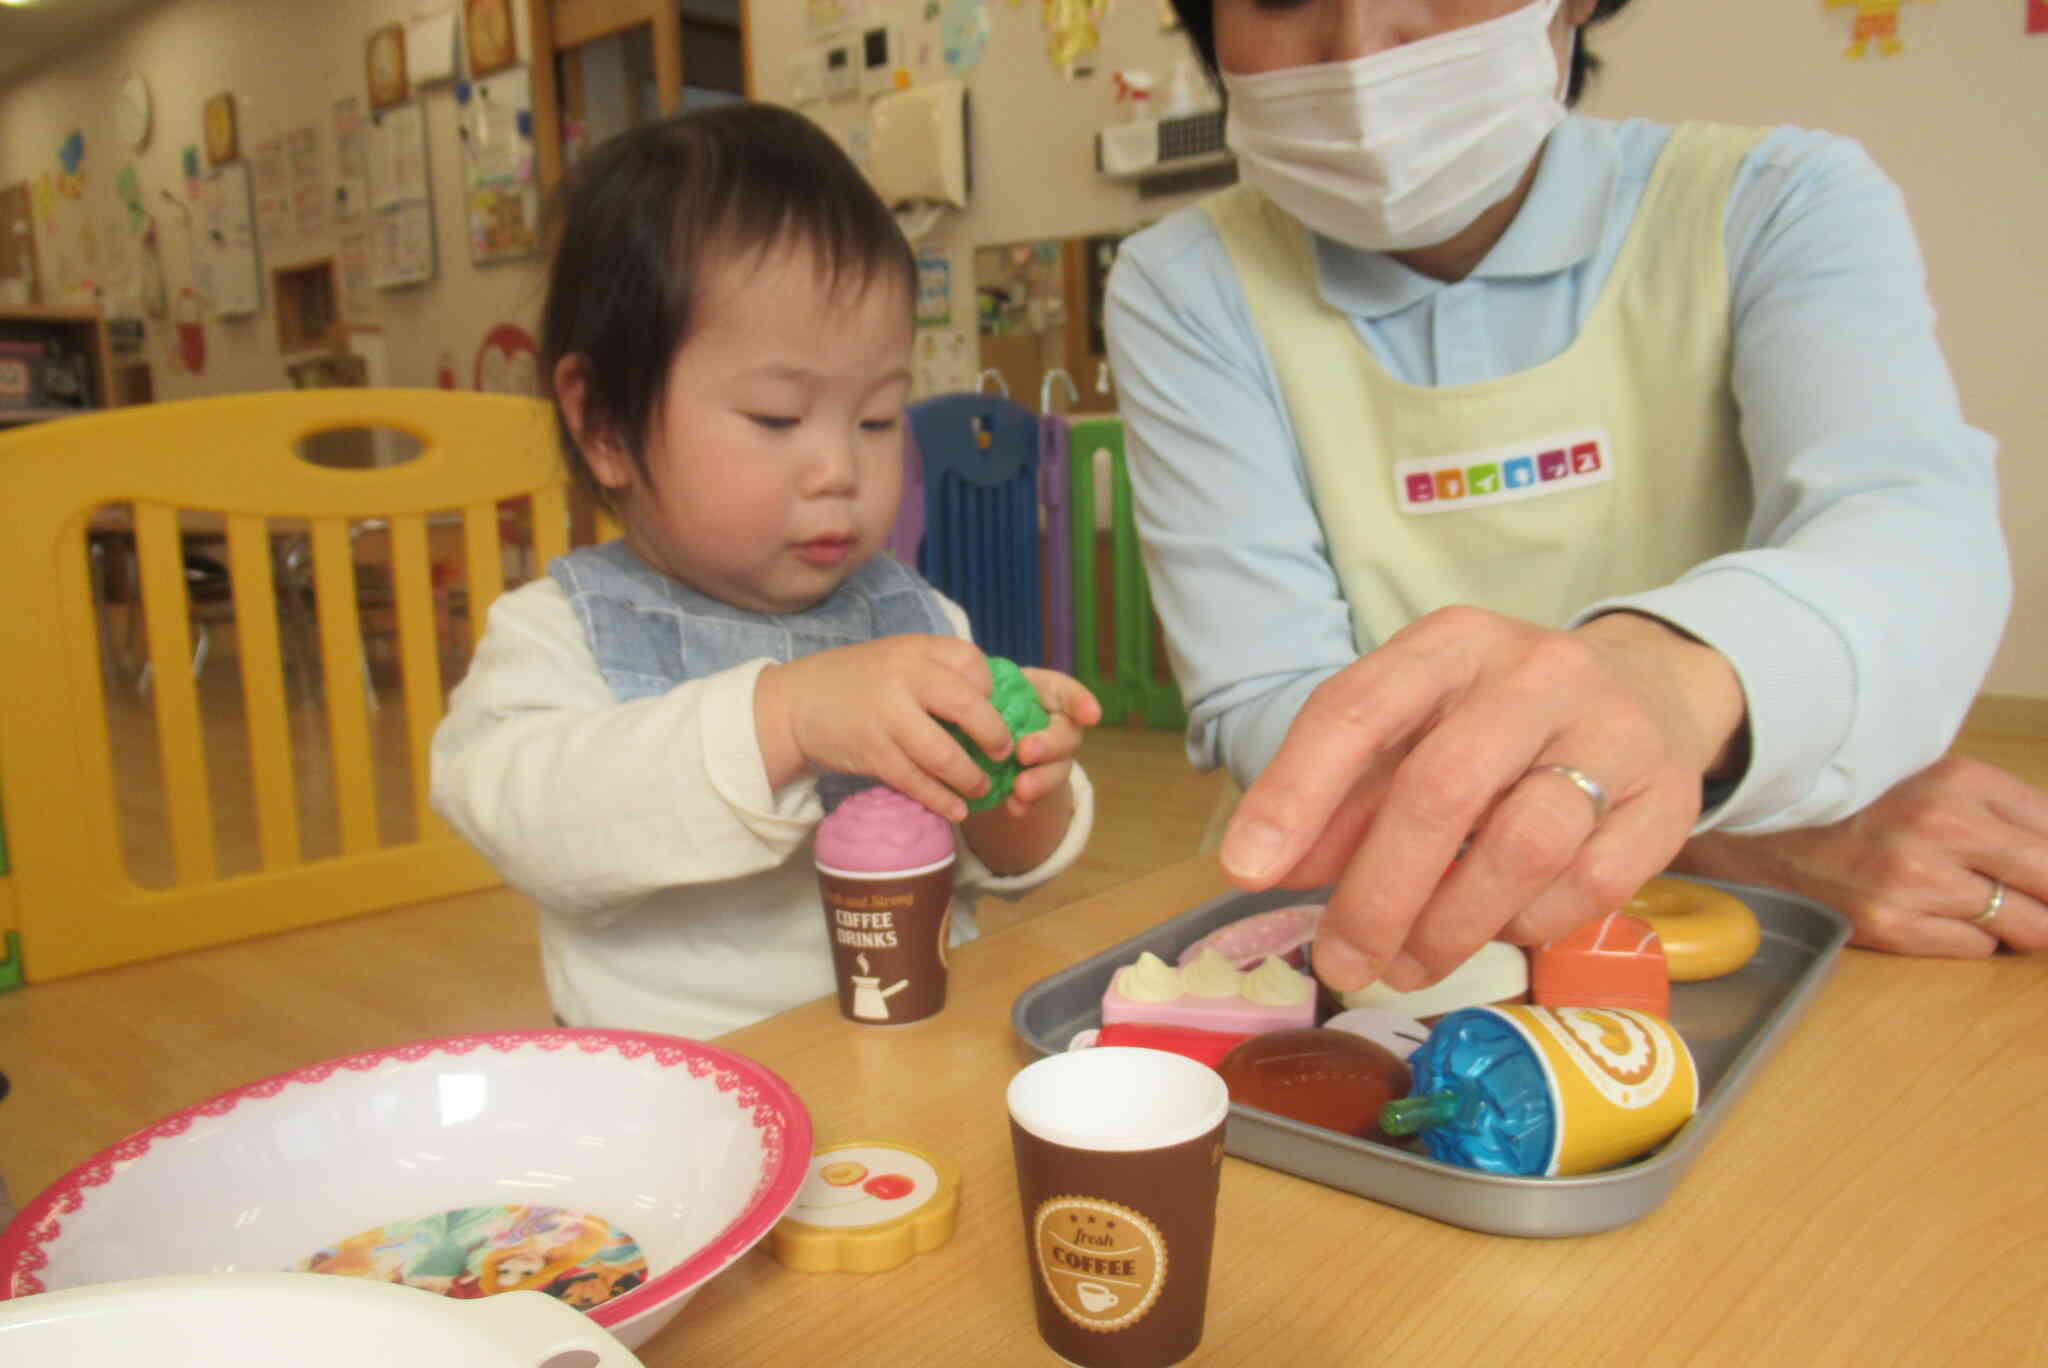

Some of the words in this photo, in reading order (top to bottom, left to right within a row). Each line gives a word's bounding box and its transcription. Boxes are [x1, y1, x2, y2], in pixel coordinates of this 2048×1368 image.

[835, 909, 894, 929] COFFEE
[836, 928, 899, 948] DRINKS
[1072, 1228, 1116, 1247] fresh
[1052, 1247, 1136, 1276] COFFEE
